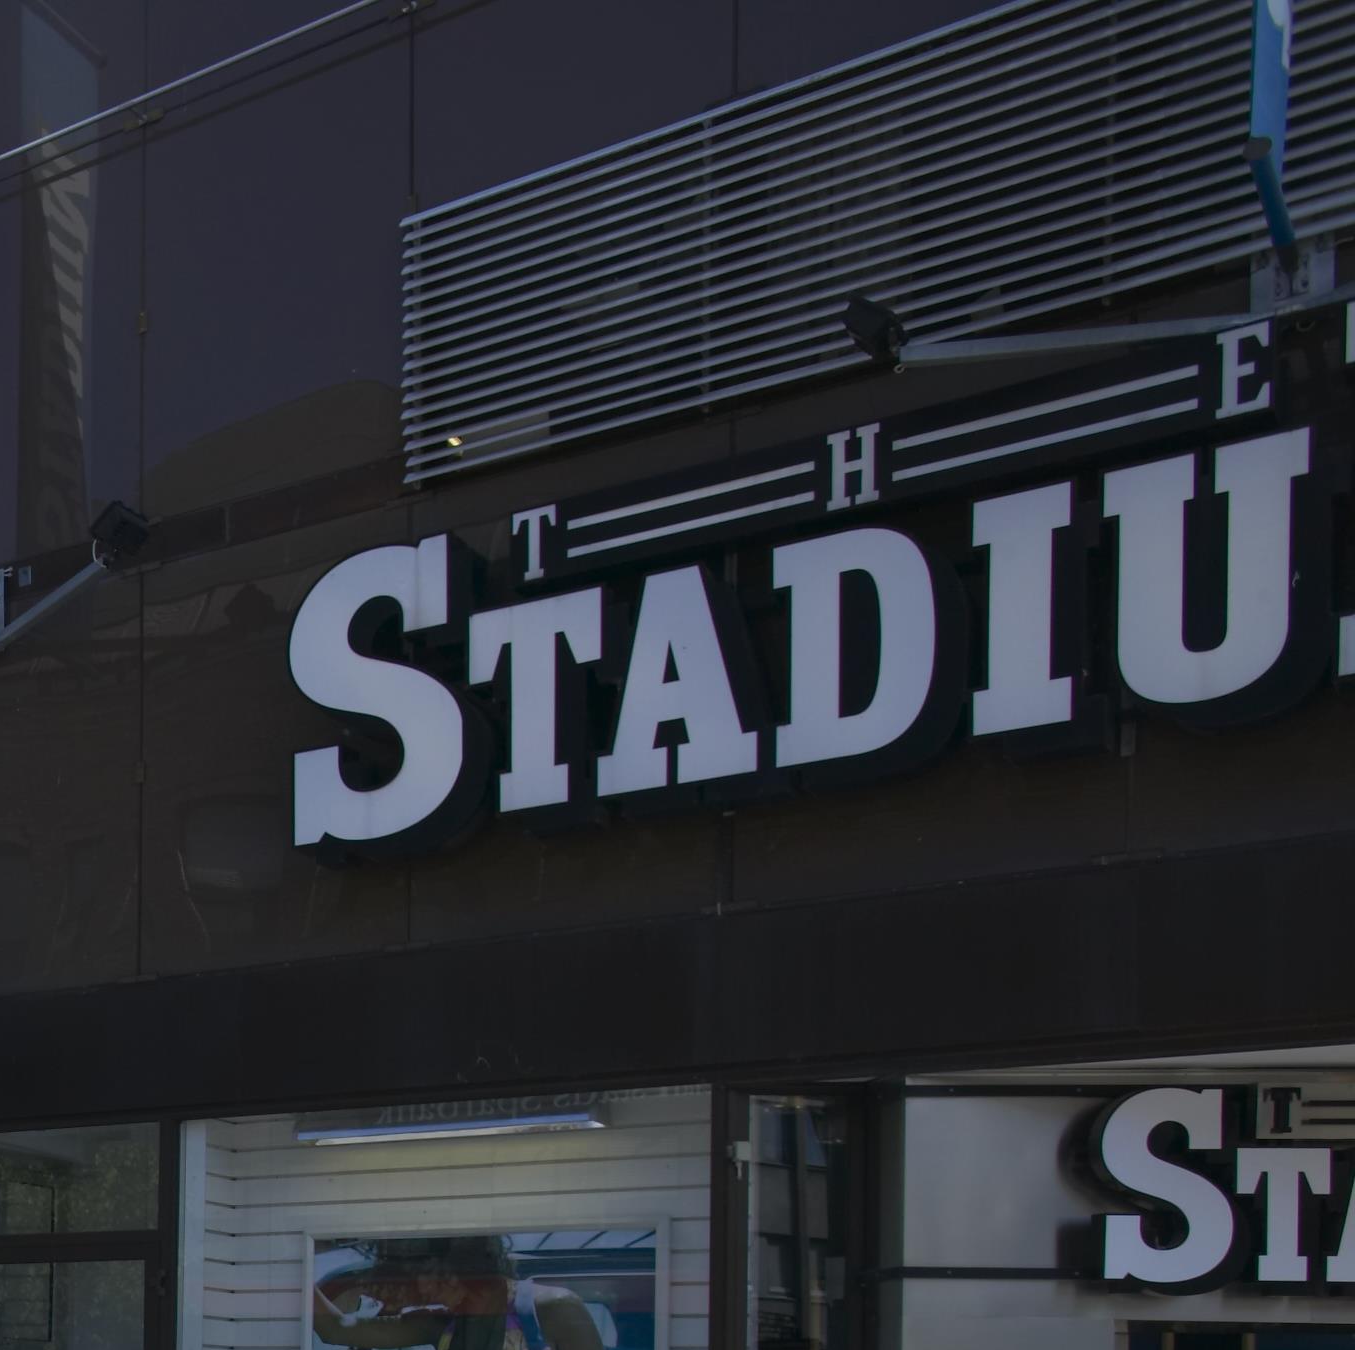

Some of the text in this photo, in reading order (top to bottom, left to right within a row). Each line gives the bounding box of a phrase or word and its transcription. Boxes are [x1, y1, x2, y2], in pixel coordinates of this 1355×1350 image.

[289, 302, 1355, 847] STADIU
[512, 320, 1271, 581] THE
[1102, 1087, 1355, 1283] ST
